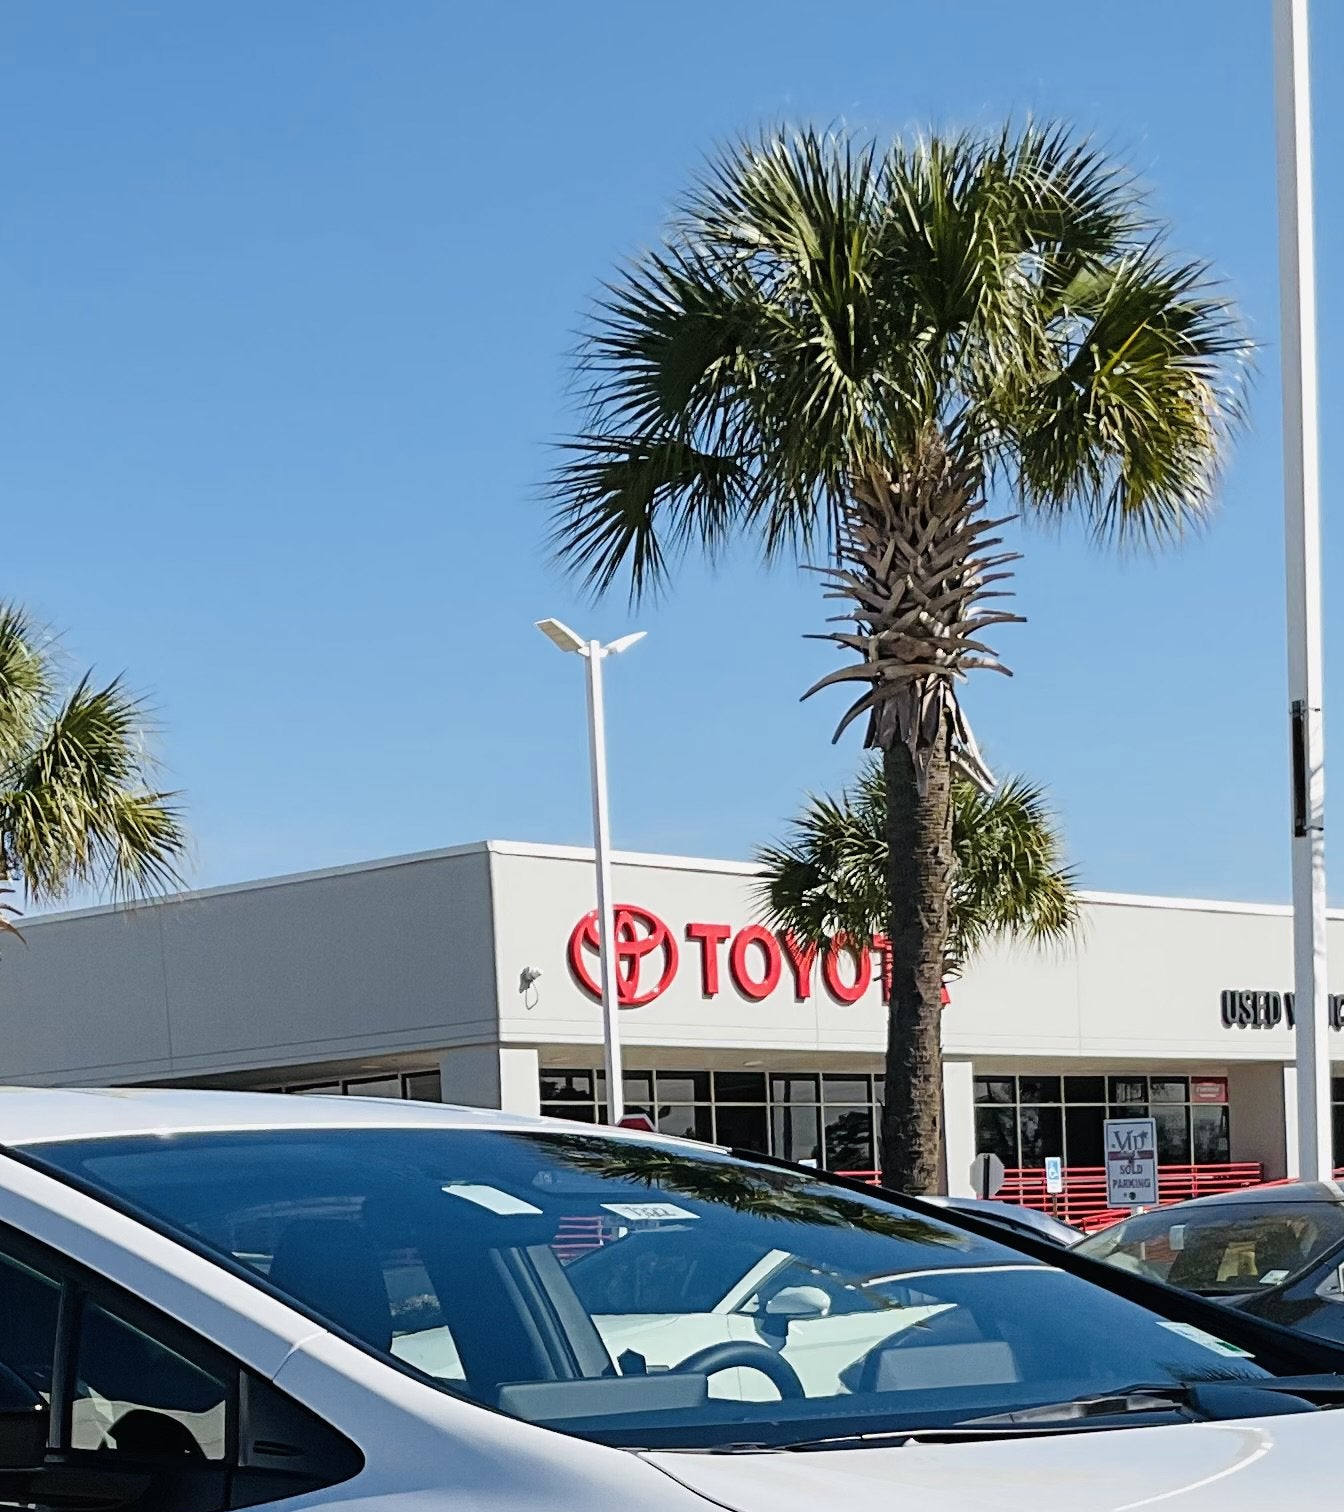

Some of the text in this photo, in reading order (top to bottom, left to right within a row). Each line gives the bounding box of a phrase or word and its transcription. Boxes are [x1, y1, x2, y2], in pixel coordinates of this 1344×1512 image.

[687, 923, 950, 1006] TOYO
[1221, 990, 1282, 1029] USED
[1120, 1164, 1143, 1174] SOLD
[1112, 1179, 1151, 1188] PARKING
